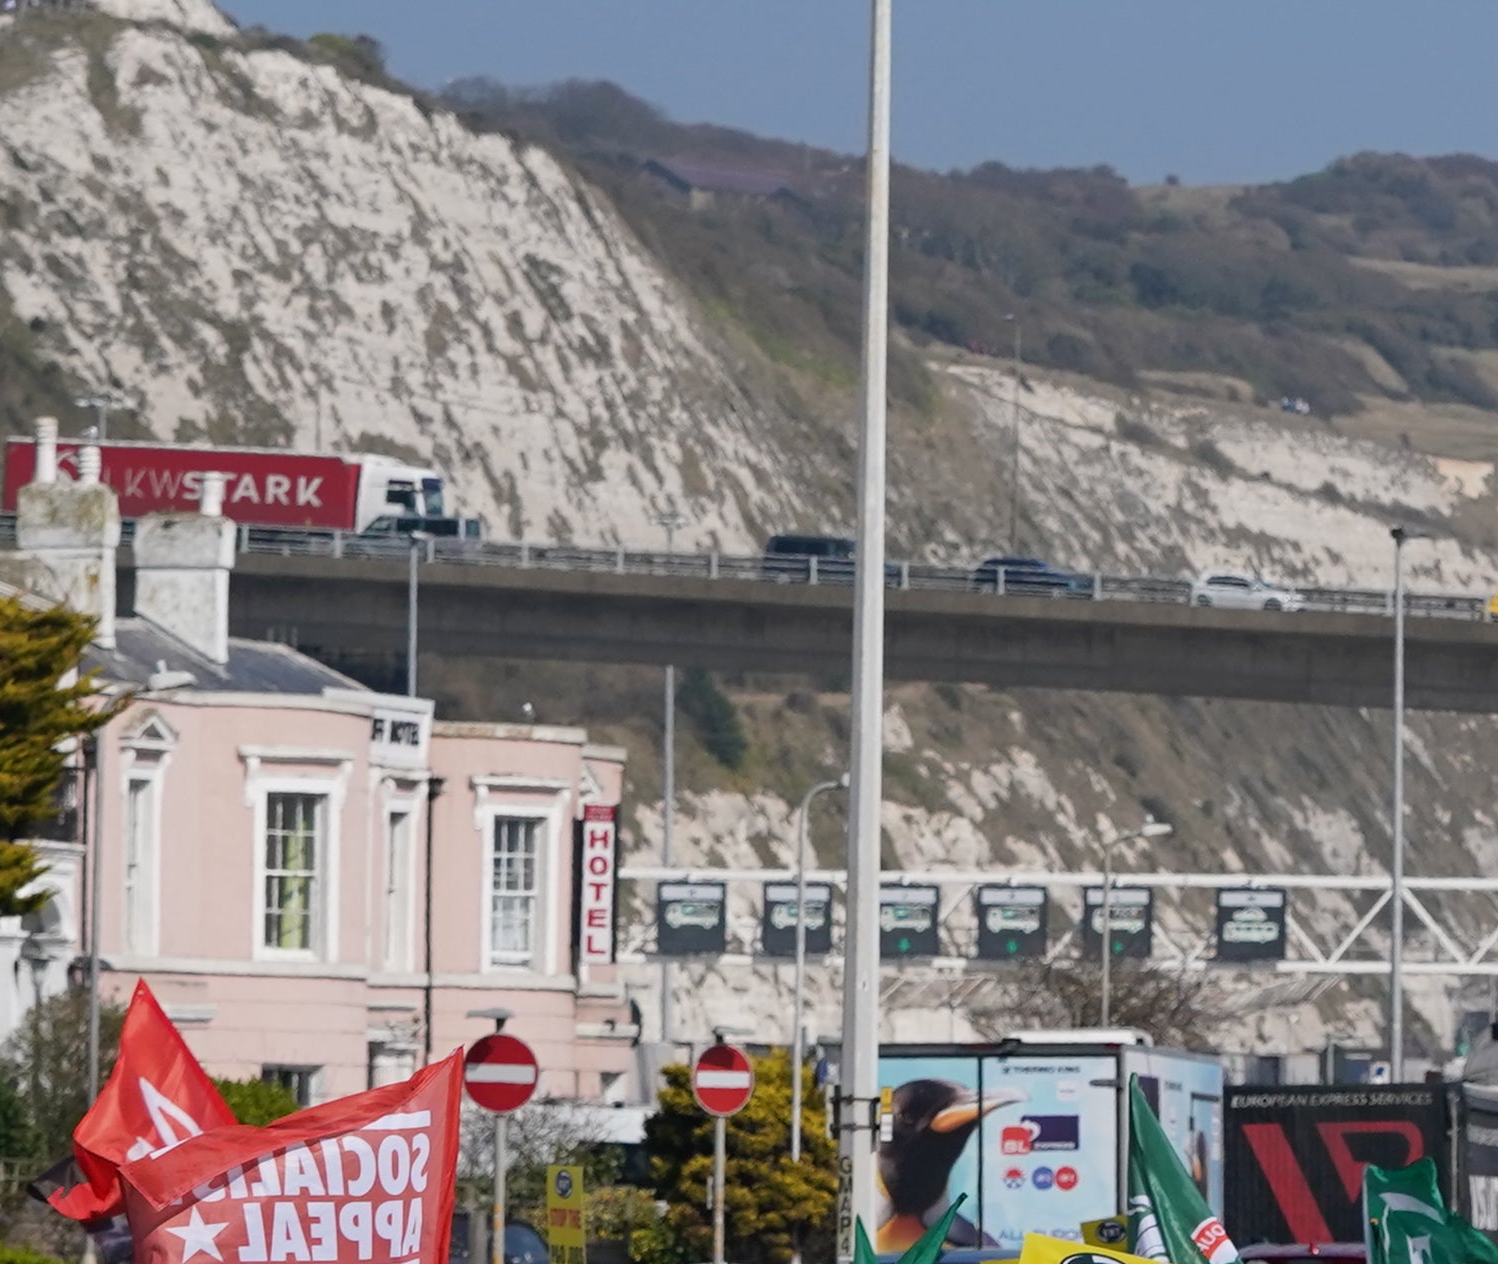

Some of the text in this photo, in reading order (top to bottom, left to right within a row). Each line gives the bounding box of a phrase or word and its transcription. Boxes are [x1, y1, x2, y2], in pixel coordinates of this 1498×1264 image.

[587, 829, 609, 954] HOTEL
[1231, 1092, 1433, 1109] EUROPEAN EXPRESS SERVICES
